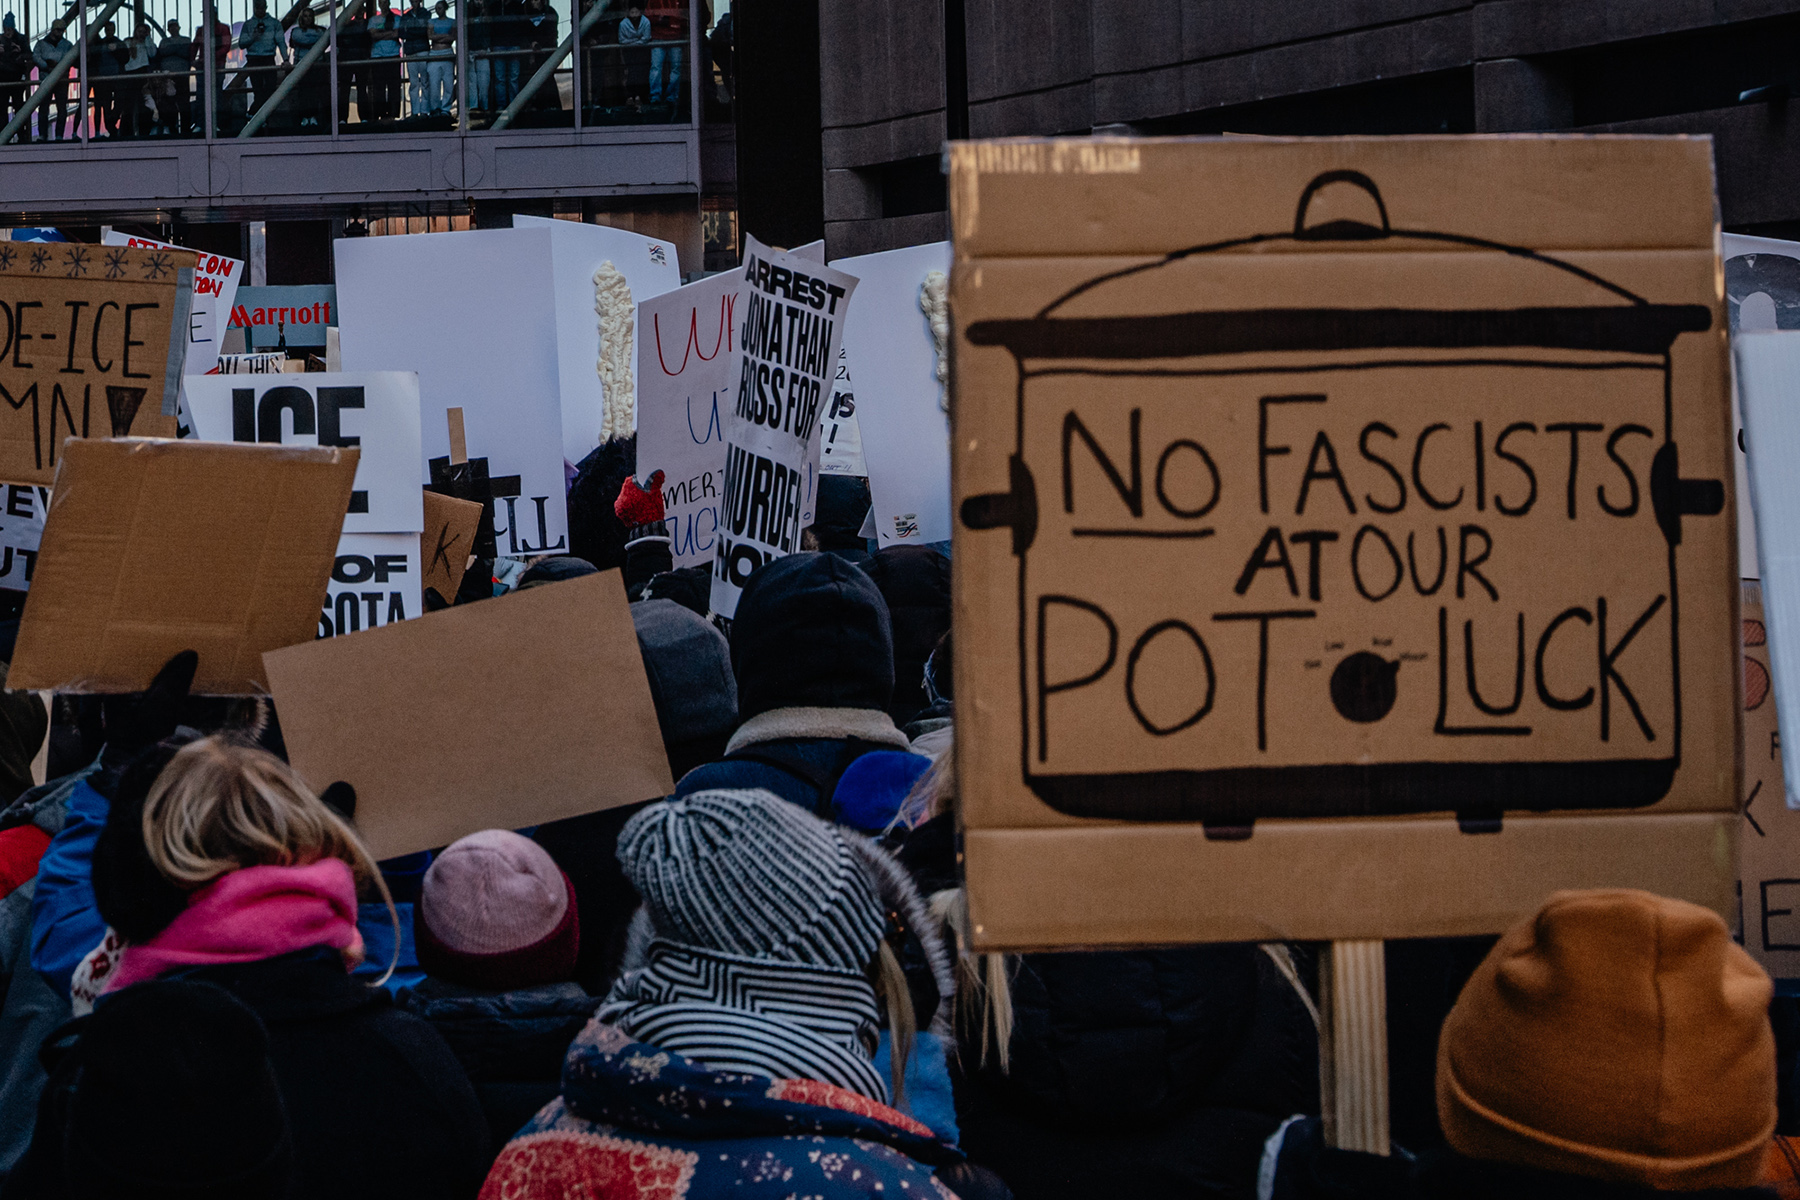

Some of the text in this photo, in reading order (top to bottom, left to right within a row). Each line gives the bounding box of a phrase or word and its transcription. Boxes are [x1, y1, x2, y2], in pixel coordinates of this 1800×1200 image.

[227, 302, 331, 327] Marriott
[745, 254, 846, 315] ARREST
[742, 291, 833, 380] JONATHAN
[737, 355, 785, 429] ROSS
[784, 372, 820, 440] FOR
[1259, 394, 1655, 520] FASCISTS
[331, 554, 408, 583] OF
[715, 533, 780, 588] NO
[1037, 594, 1668, 764] POT LUCK
